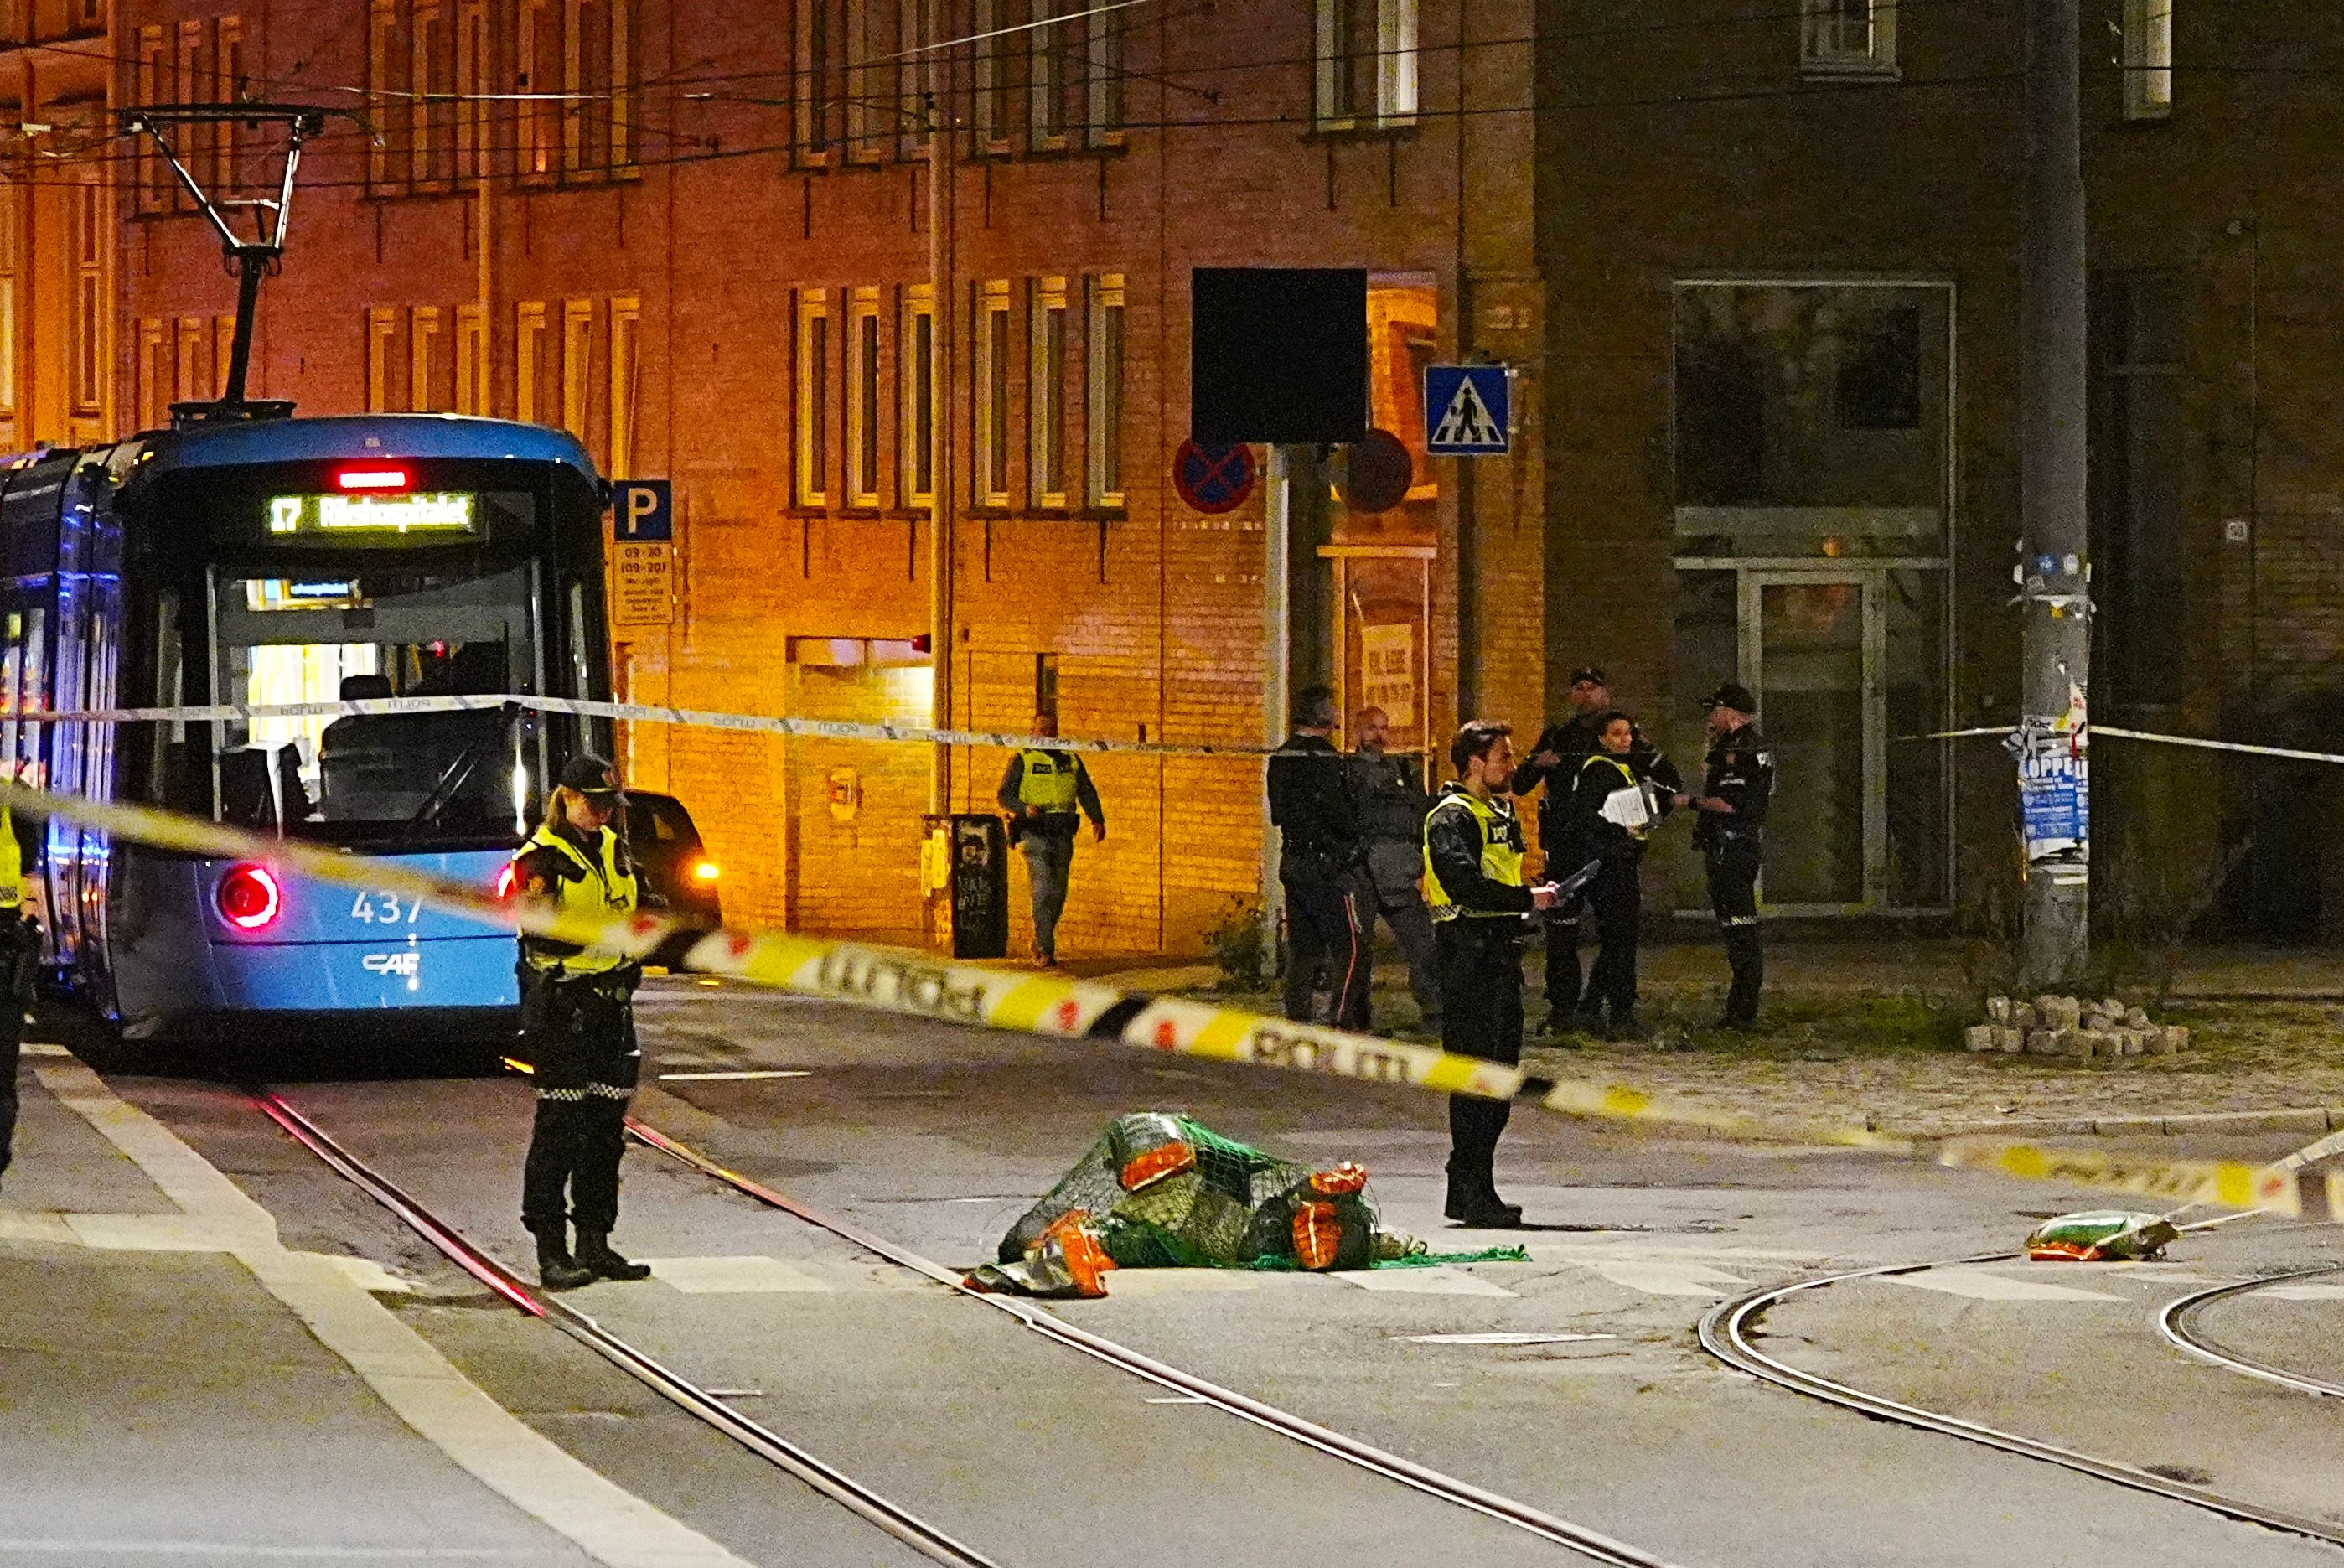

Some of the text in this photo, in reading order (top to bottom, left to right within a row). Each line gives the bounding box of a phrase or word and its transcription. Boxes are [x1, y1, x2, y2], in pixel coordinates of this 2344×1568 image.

[270, 497, 302, 532] 17
[628, 487, 658, 535] P
[361, 953, 420, 975] CAF
